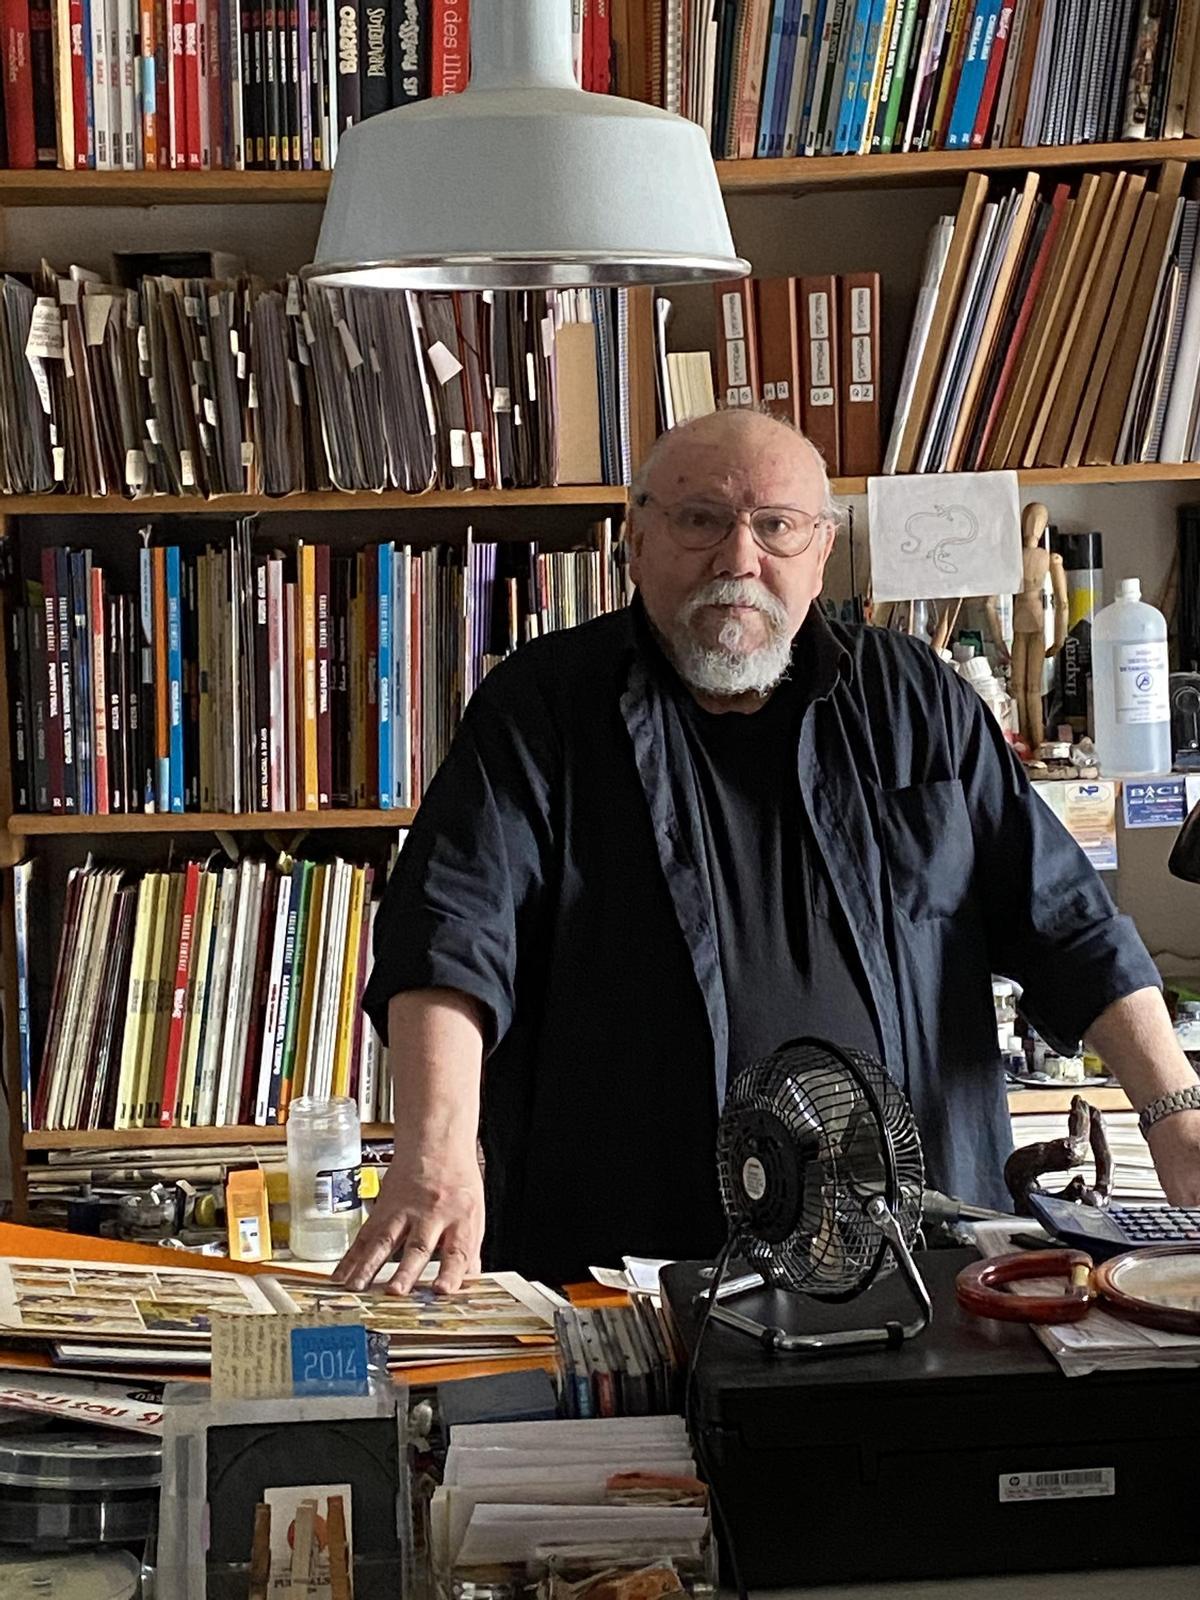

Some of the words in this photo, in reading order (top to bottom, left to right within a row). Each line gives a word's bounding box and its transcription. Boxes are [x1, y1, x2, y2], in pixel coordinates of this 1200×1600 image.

[443, 10, 462, 49] des
[48, 663, 57, 692] PUNTO
[320, 659, 328, 687] PUNTO
[1065, 636, 1079, 697] fixpray
[53, 797, 61, 807] R
[66, 797, 74, 807] R
[268, 1107, 276, 1118] R
[304, 1350, 357, 1382] 2014
